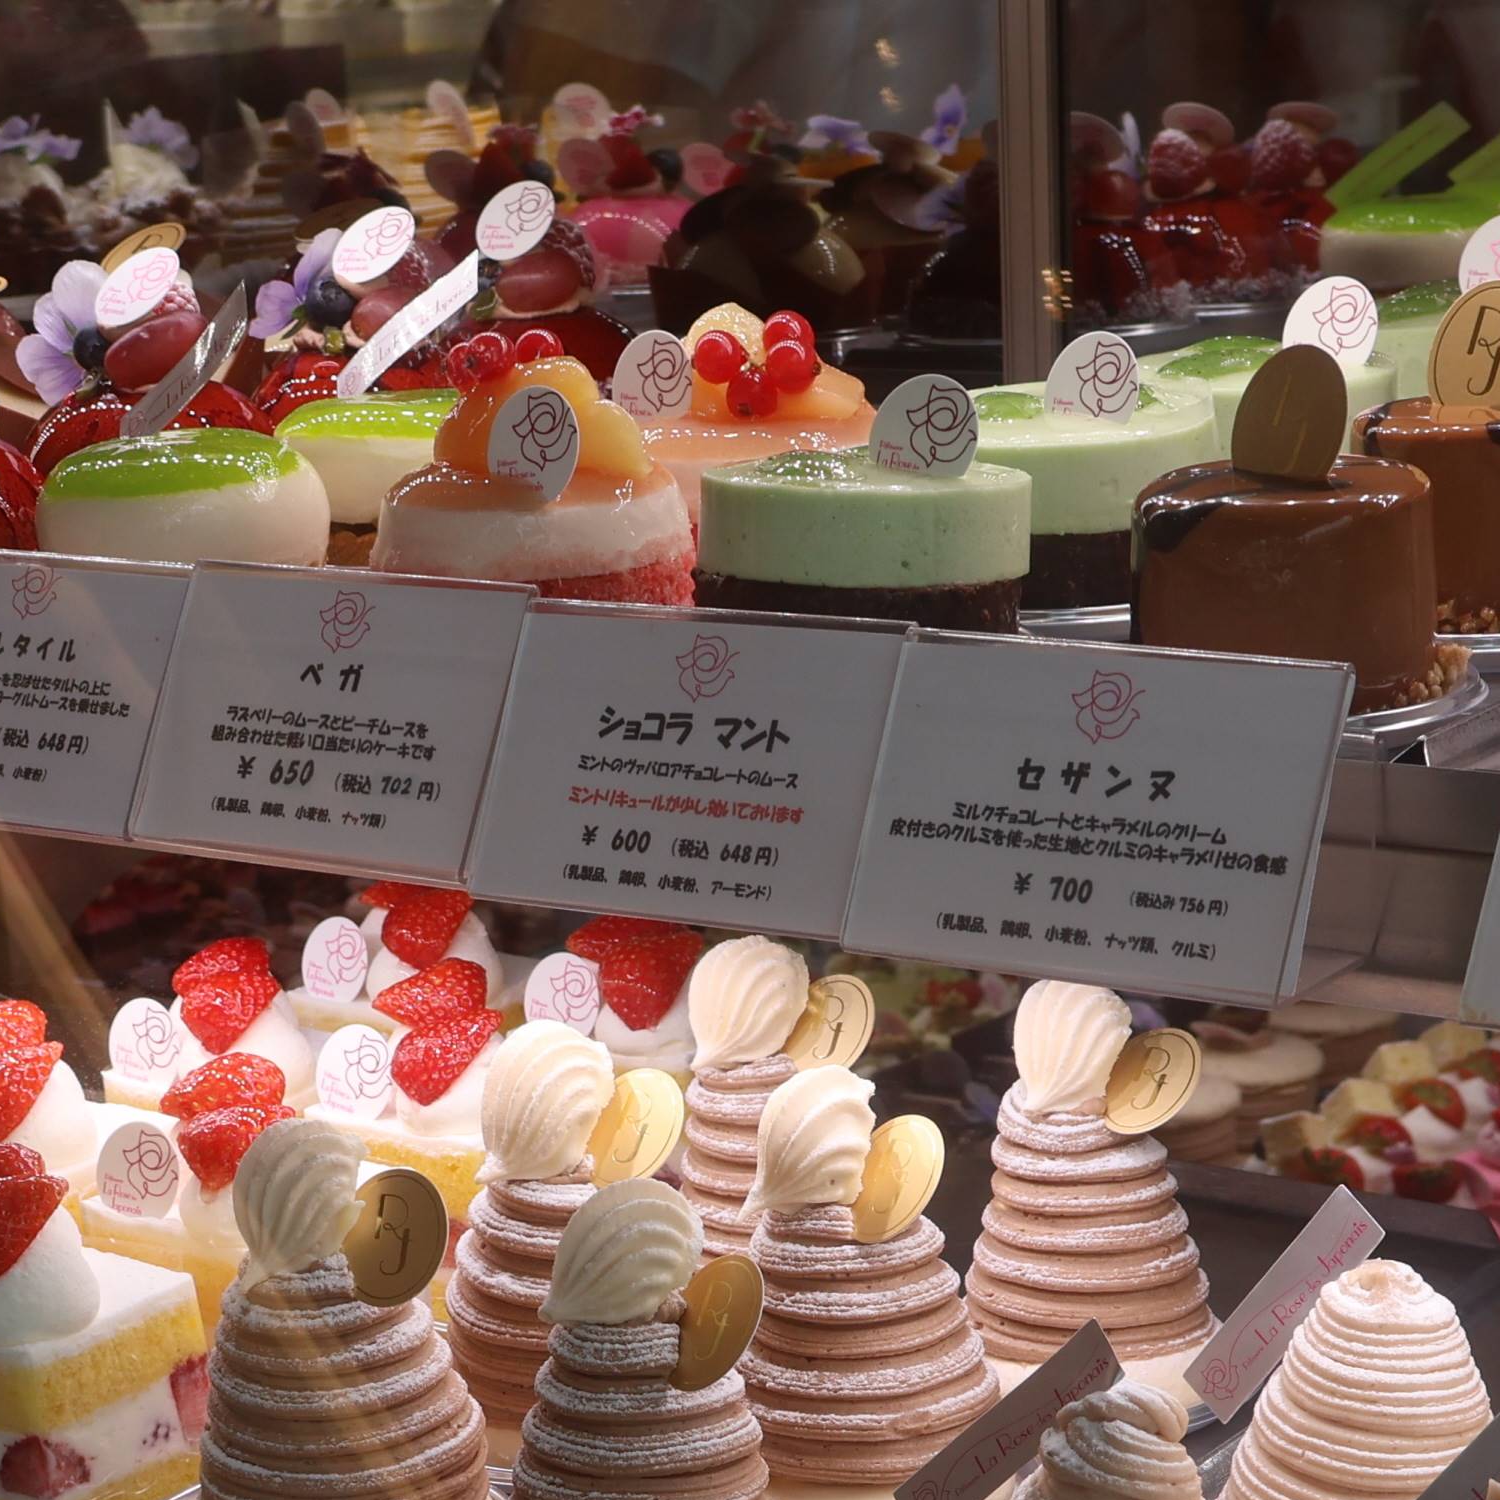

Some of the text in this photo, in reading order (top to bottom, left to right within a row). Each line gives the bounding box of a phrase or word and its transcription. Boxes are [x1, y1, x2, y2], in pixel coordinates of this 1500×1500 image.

[300, 663, 364, 693] ベガ
[38, 733, 89, 755] 648円)
[211, 726, 436, 761] 組み合わせた軽い口当たりのケーキです
[598, 706, 790, 753] ショコラ マント
[238, 756, 256, 779] ¥
[270, 759, 315, 787] 650
[335, 772, 371, 794] (税込
[578, 754, 799, 790] ミントのヴァバロアチョコレートのムース
[1017, 758, 1176, 802] セザンヌ
[568, 785, 805, 825] ミントリキュールが少し効いております
[952, 801, 1227, 845] ミルクチョコレートとキャラメルのクリーム
[582, 825, 779, 867] ¥ 600 (税込 648円)
[889, 817, 1288, 877] 皮付きのクルミを使った生地とクルミのキャラメリゼの食感
[1013, 872, 1093, 904] ¥ 700
[1271, 1285, 1308, 1328] Rose
